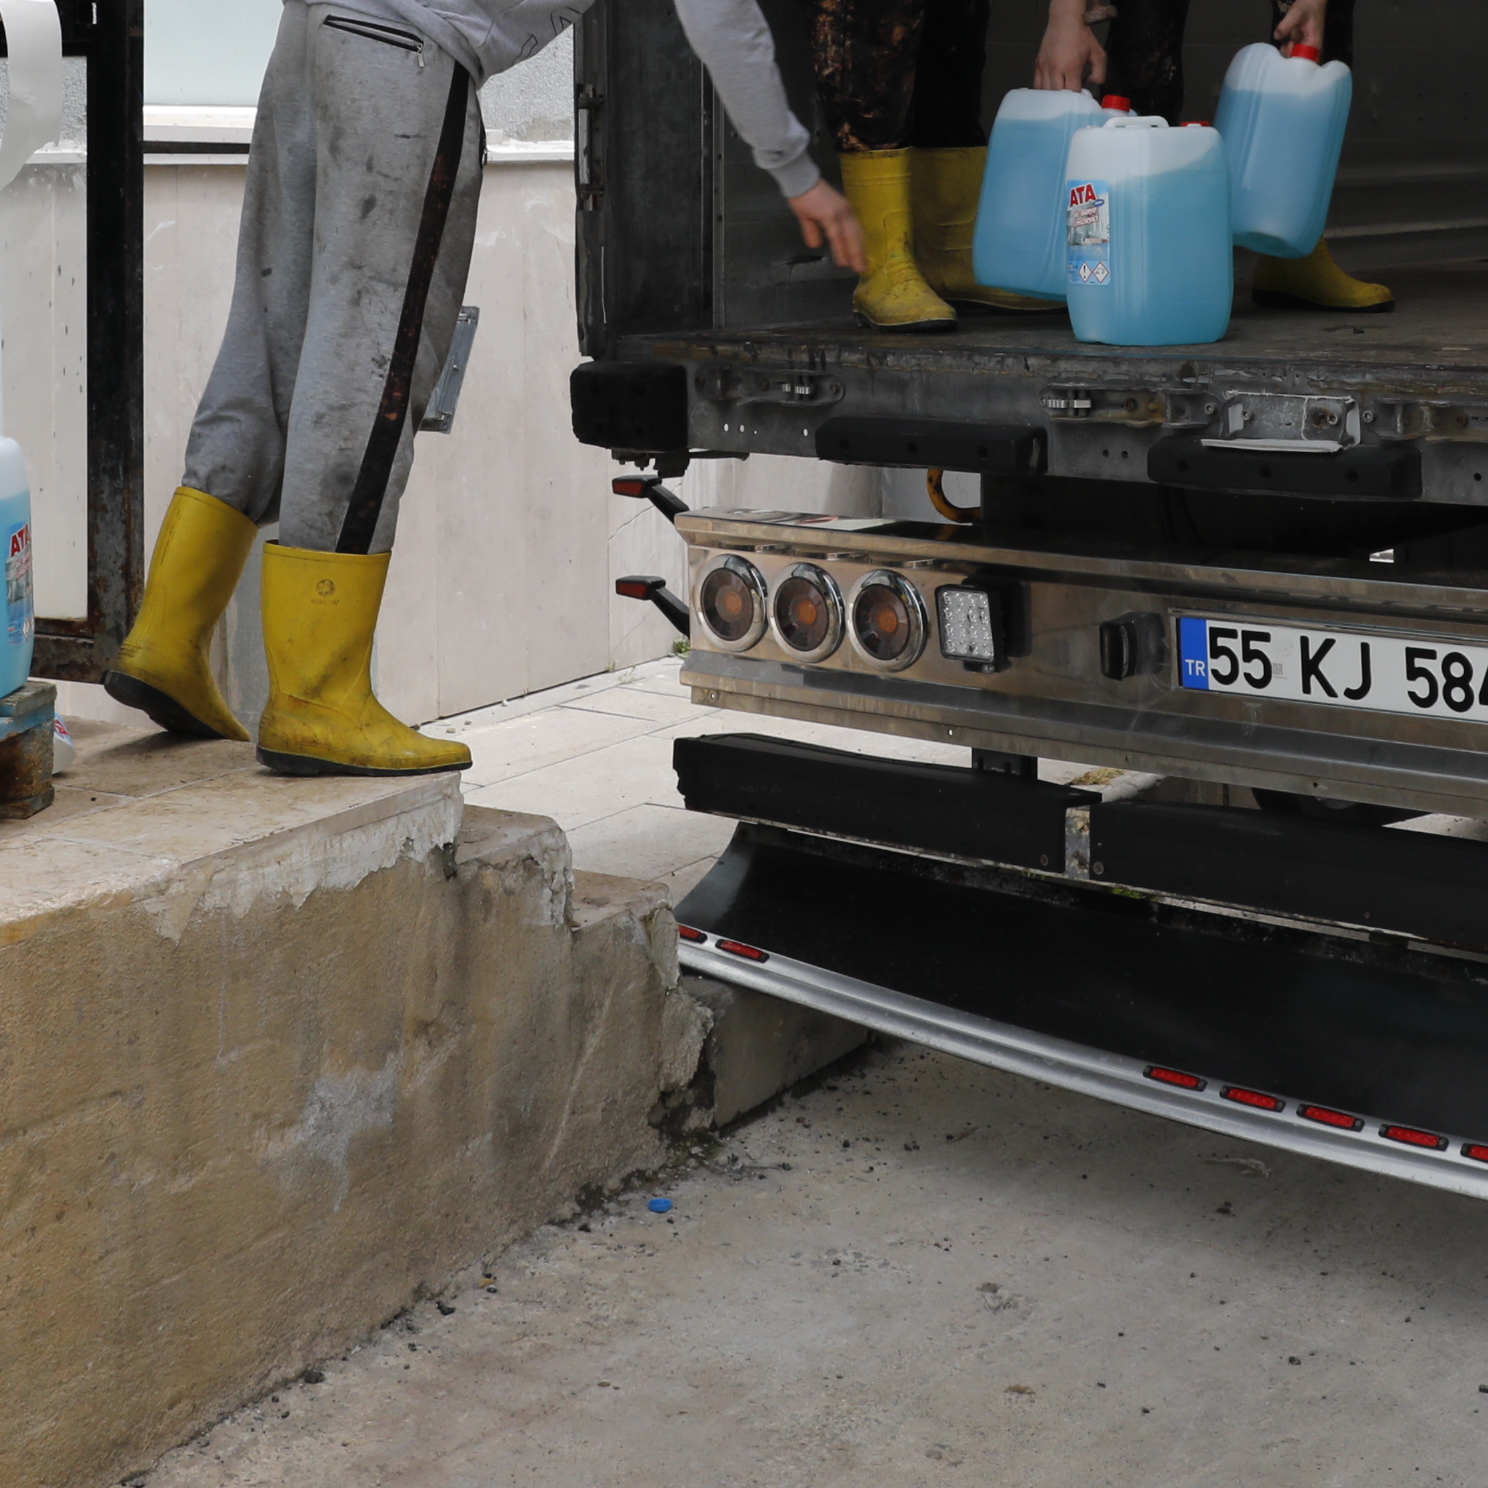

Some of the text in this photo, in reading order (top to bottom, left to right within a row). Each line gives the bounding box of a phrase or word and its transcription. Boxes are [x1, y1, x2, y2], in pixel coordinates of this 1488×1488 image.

[1069, 183, 1097, 208] ATA
[10, 523, 31, 558] ATA
[1185, 659, 1206, 677] TR
[1209, 626, 1273, 689] 55
[1300, 636, 1372, 701] KJ
